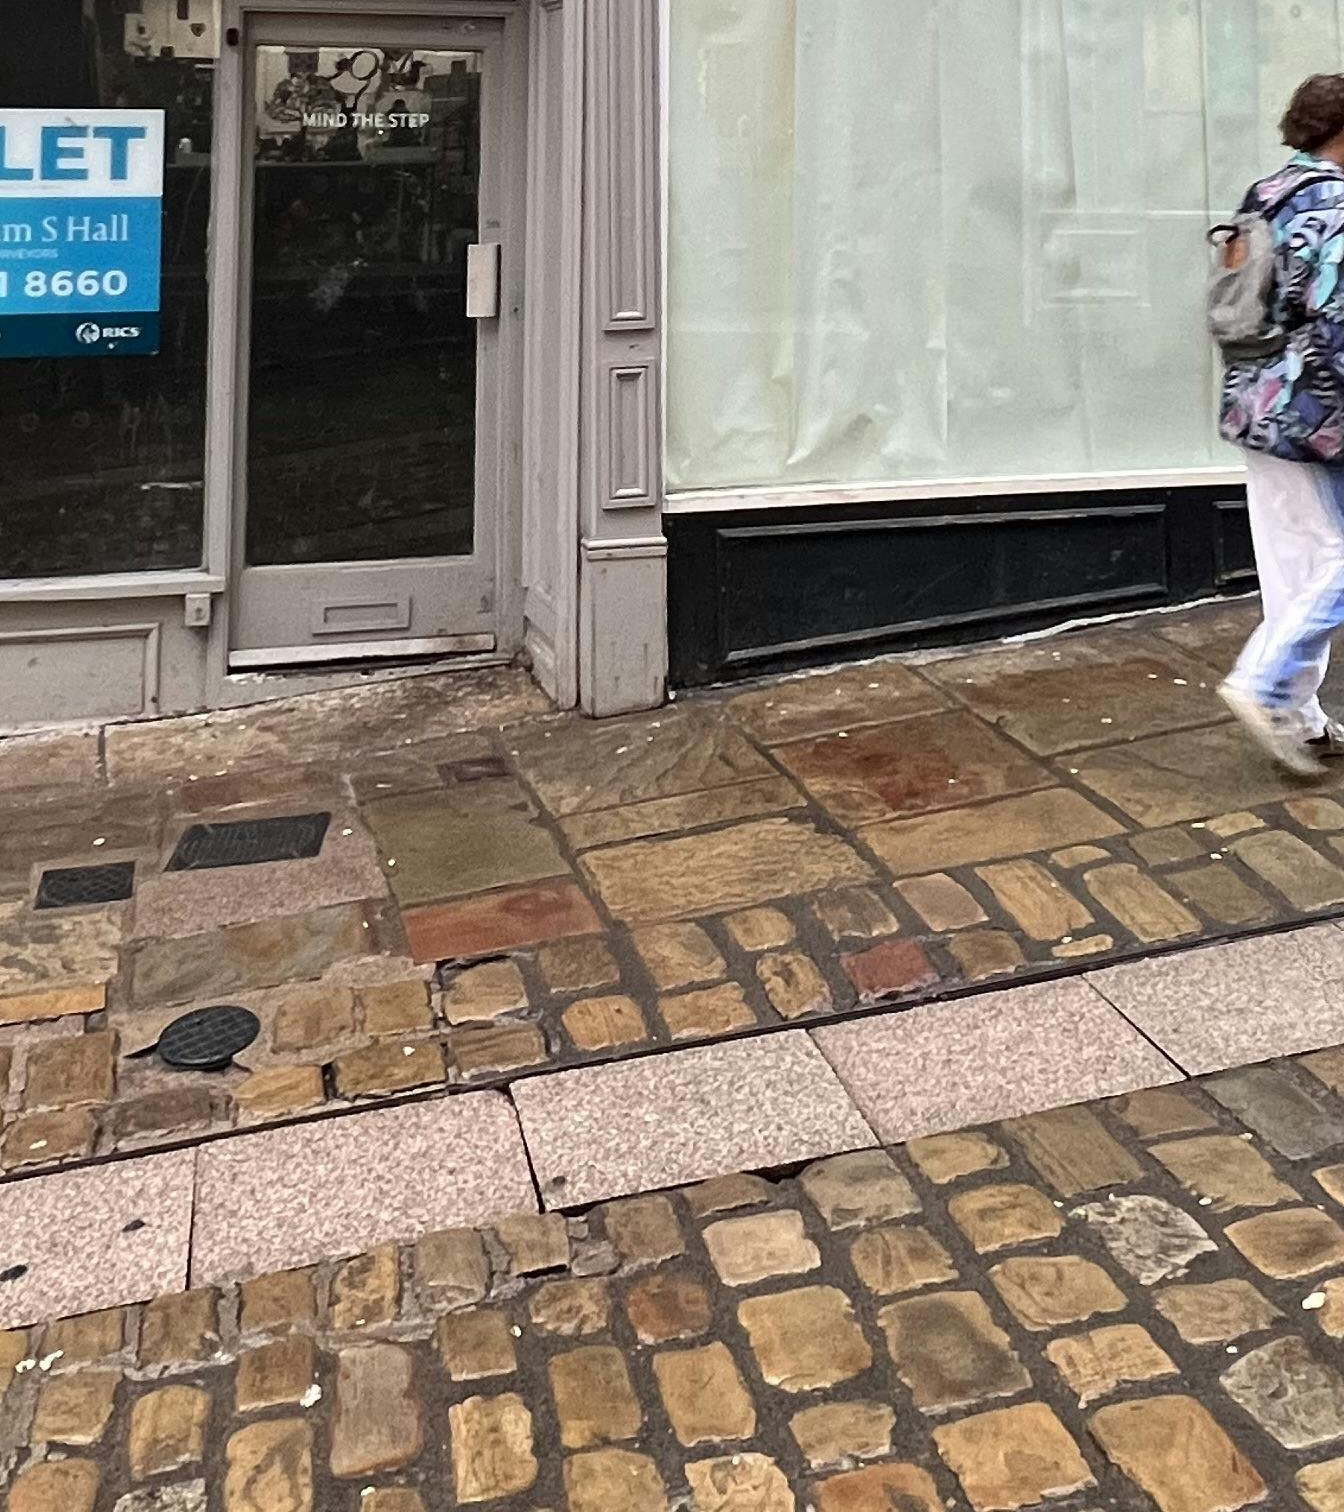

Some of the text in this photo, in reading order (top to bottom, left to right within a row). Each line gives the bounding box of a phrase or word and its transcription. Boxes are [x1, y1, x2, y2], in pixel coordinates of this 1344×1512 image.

[302, 113, 430, 128] MIND THE STEP
[41, 216, 58, 242] S
[66, 214, 128, 242] Hall
[24, 270, 128, 298] 8660
[101, 326, 141, 338] RICS
